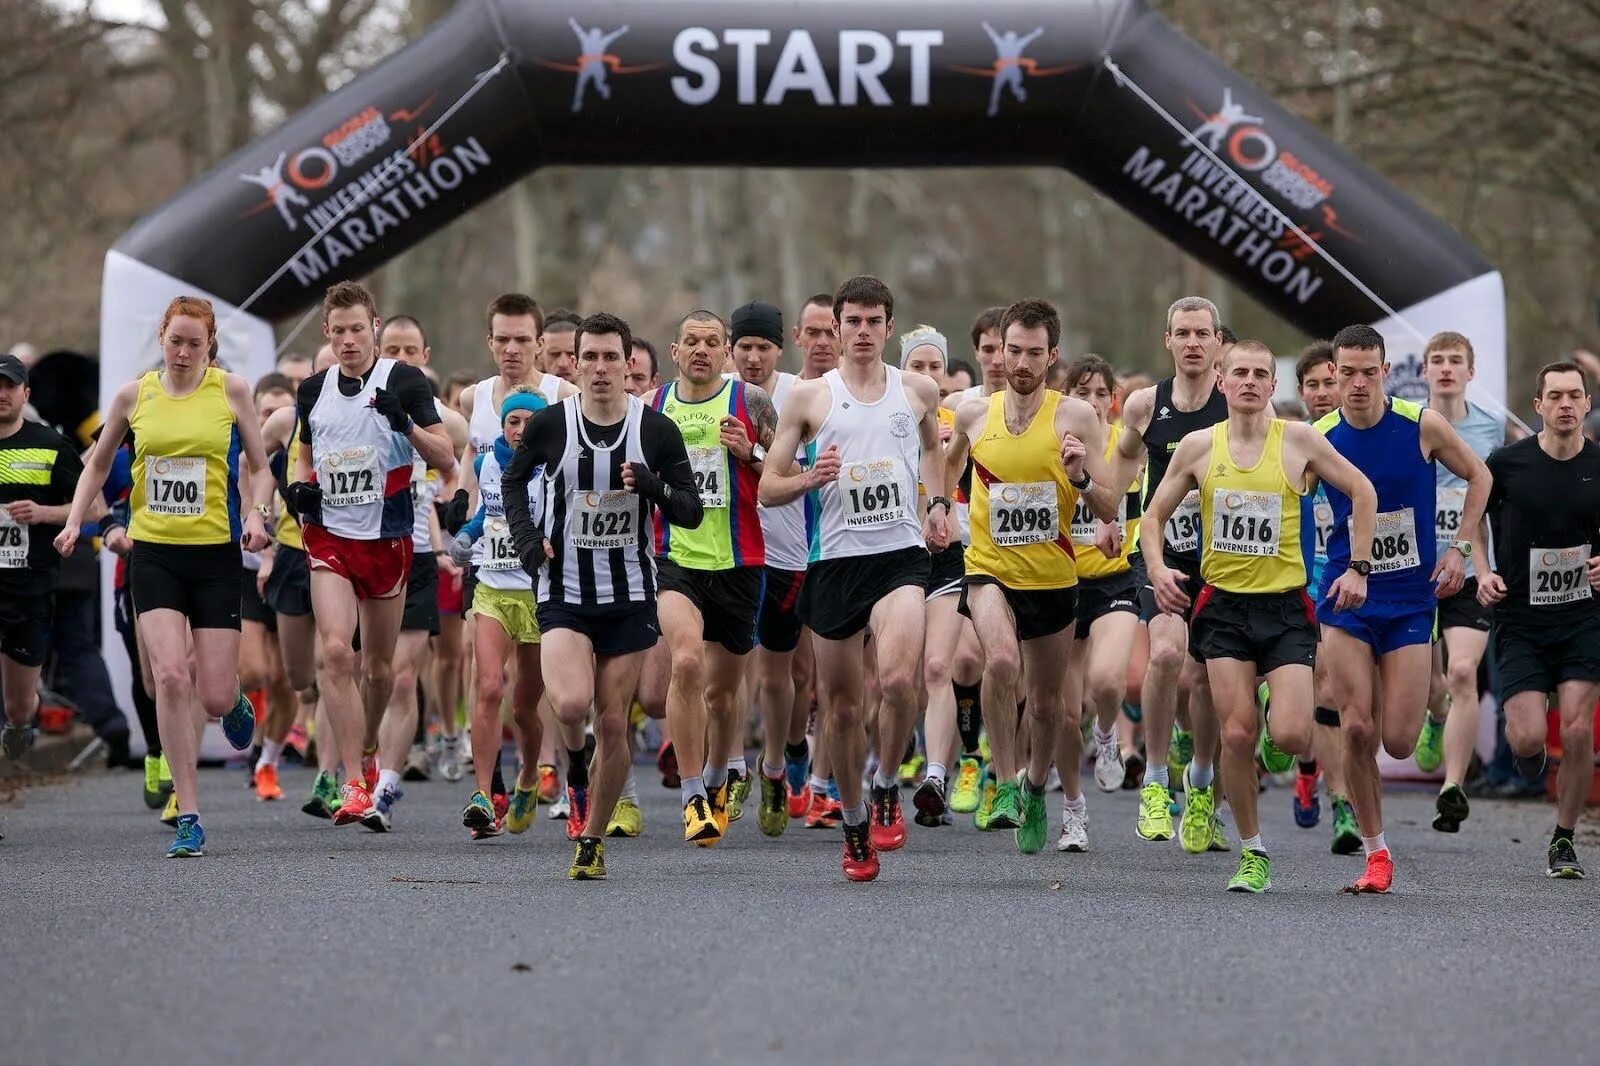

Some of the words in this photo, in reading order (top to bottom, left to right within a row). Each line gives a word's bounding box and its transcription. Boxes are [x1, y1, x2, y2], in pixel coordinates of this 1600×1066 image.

[670, 26, 944, 106] START
[303, 147, 416, 234] INVERNESS
[1179, 150, 1285, 239] INVERNESS
[290, 136, 491, 287] MARATHON
[1122, 145, 1323, 303] MARATHON
[171, 459, 195, 467] GLOBAL
[868, 460, 894, 471] GLOBAL
[153, 479, 198, 503] 1700
[329, 469, 374, 495] 1272
[710, 498, 722, 506] 1/2
[849, 482, 901, 514] 1691
[1244, 494, 1269, 502] GLOBAL
[190, 506, 202, 514] 1/2
[847, 511, 894, 526] INVERNESS
[997, 507, 1051, 532] 2098
[1377, 514, 1403, 523] GLOBAL
[1434, 510, 1463, 530] 43
[581, 511, 631, 537] 1622
[1222, 514, 1273, 543] 1616
[0, 526, 22, 547] 78
[573, 538, 620, 548] INVERNESS
[1371, 533, 1409, 560] 086
[1213, 541, 1259, 554] INVERNESS
[1262, 546, 1274, 555] 1/2
[1404, 557, 1416, 566] 1/2
[1537, 566, 1584, 592] 2097
[1532, 592, 1575, 603] INVERNESS
